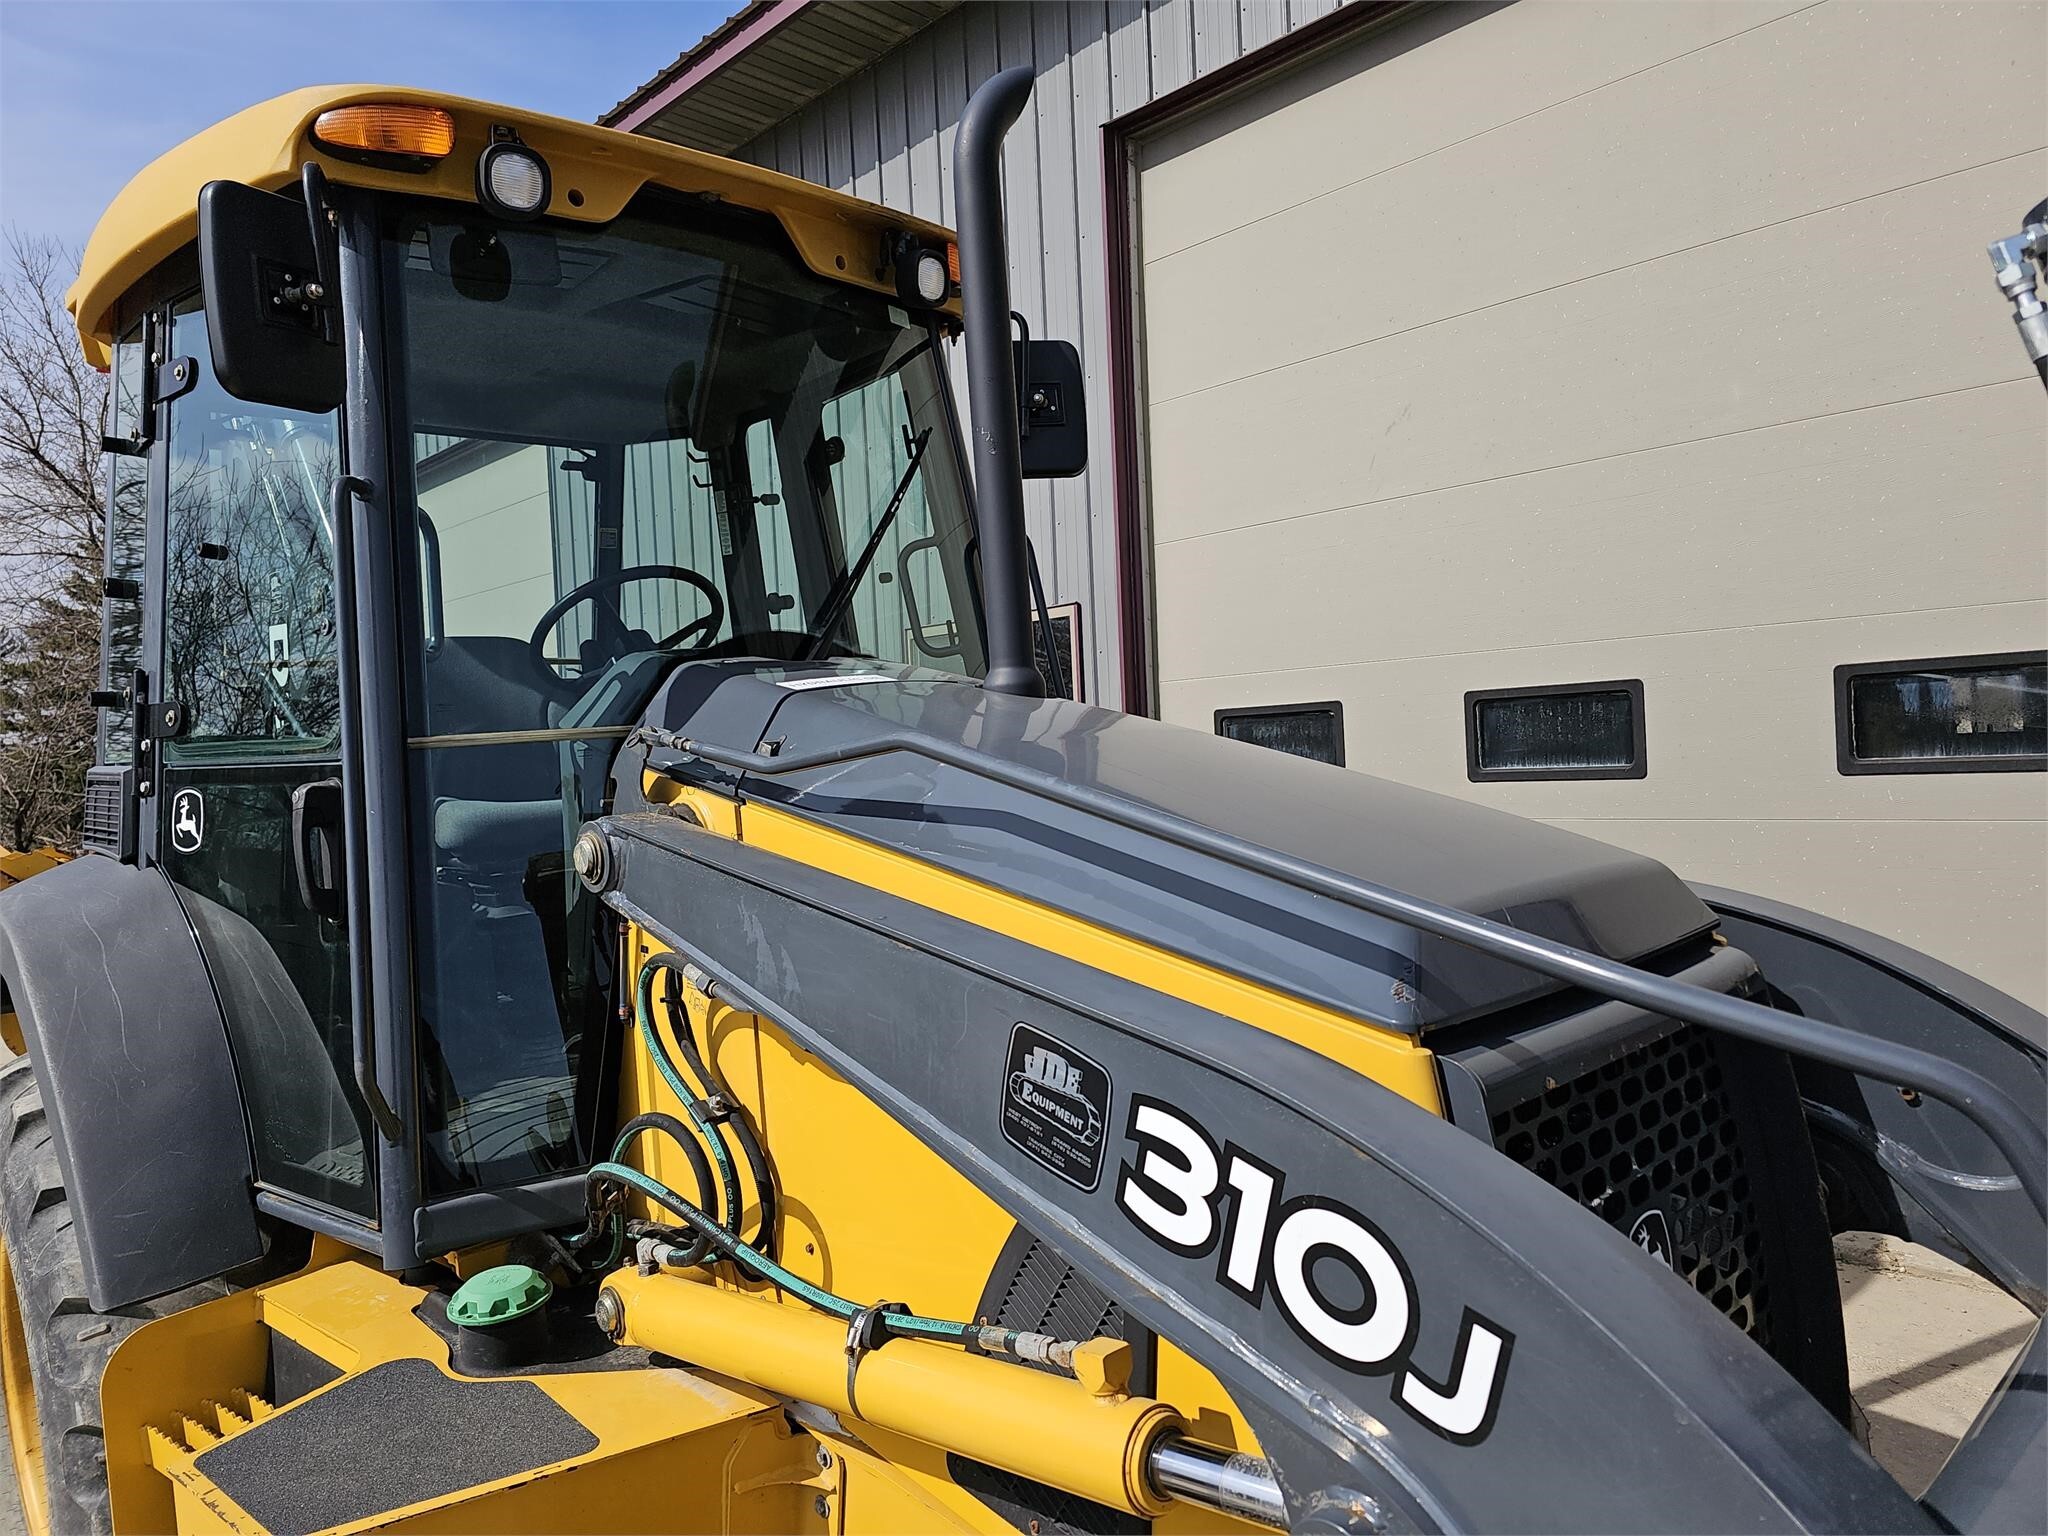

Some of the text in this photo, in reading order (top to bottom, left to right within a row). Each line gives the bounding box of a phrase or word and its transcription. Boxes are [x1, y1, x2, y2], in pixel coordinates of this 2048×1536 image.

[1024, 1046, 1084, 1096] JDE
[1022, 1080, 1084, 1131] EQUIPMENT
[1028, 1136, 1053, 1155] TRAVERSE
[741, 1246, 772, 1272] AEROQUIP
[1120, 1100, 1507, 1440] 310J
